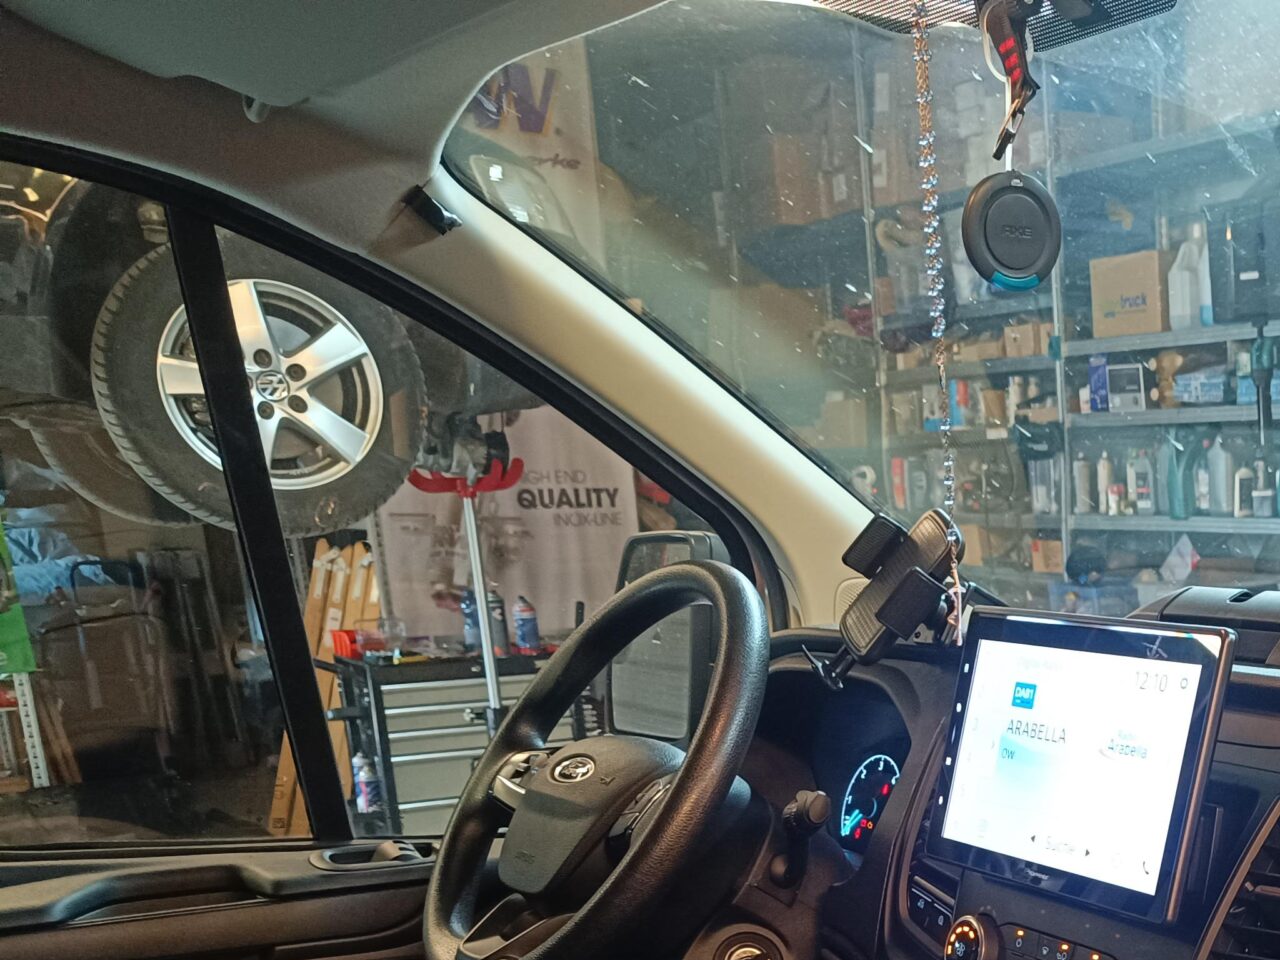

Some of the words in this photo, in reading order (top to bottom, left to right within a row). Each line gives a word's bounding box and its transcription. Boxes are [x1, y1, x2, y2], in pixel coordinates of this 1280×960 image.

[554, 469, 588, 485] END
[516, 487, 619, 511] QUALITY
[552, 511, 623, 528] INOX-LINE
[1006, 718, 1068, 744] ARABELLA
